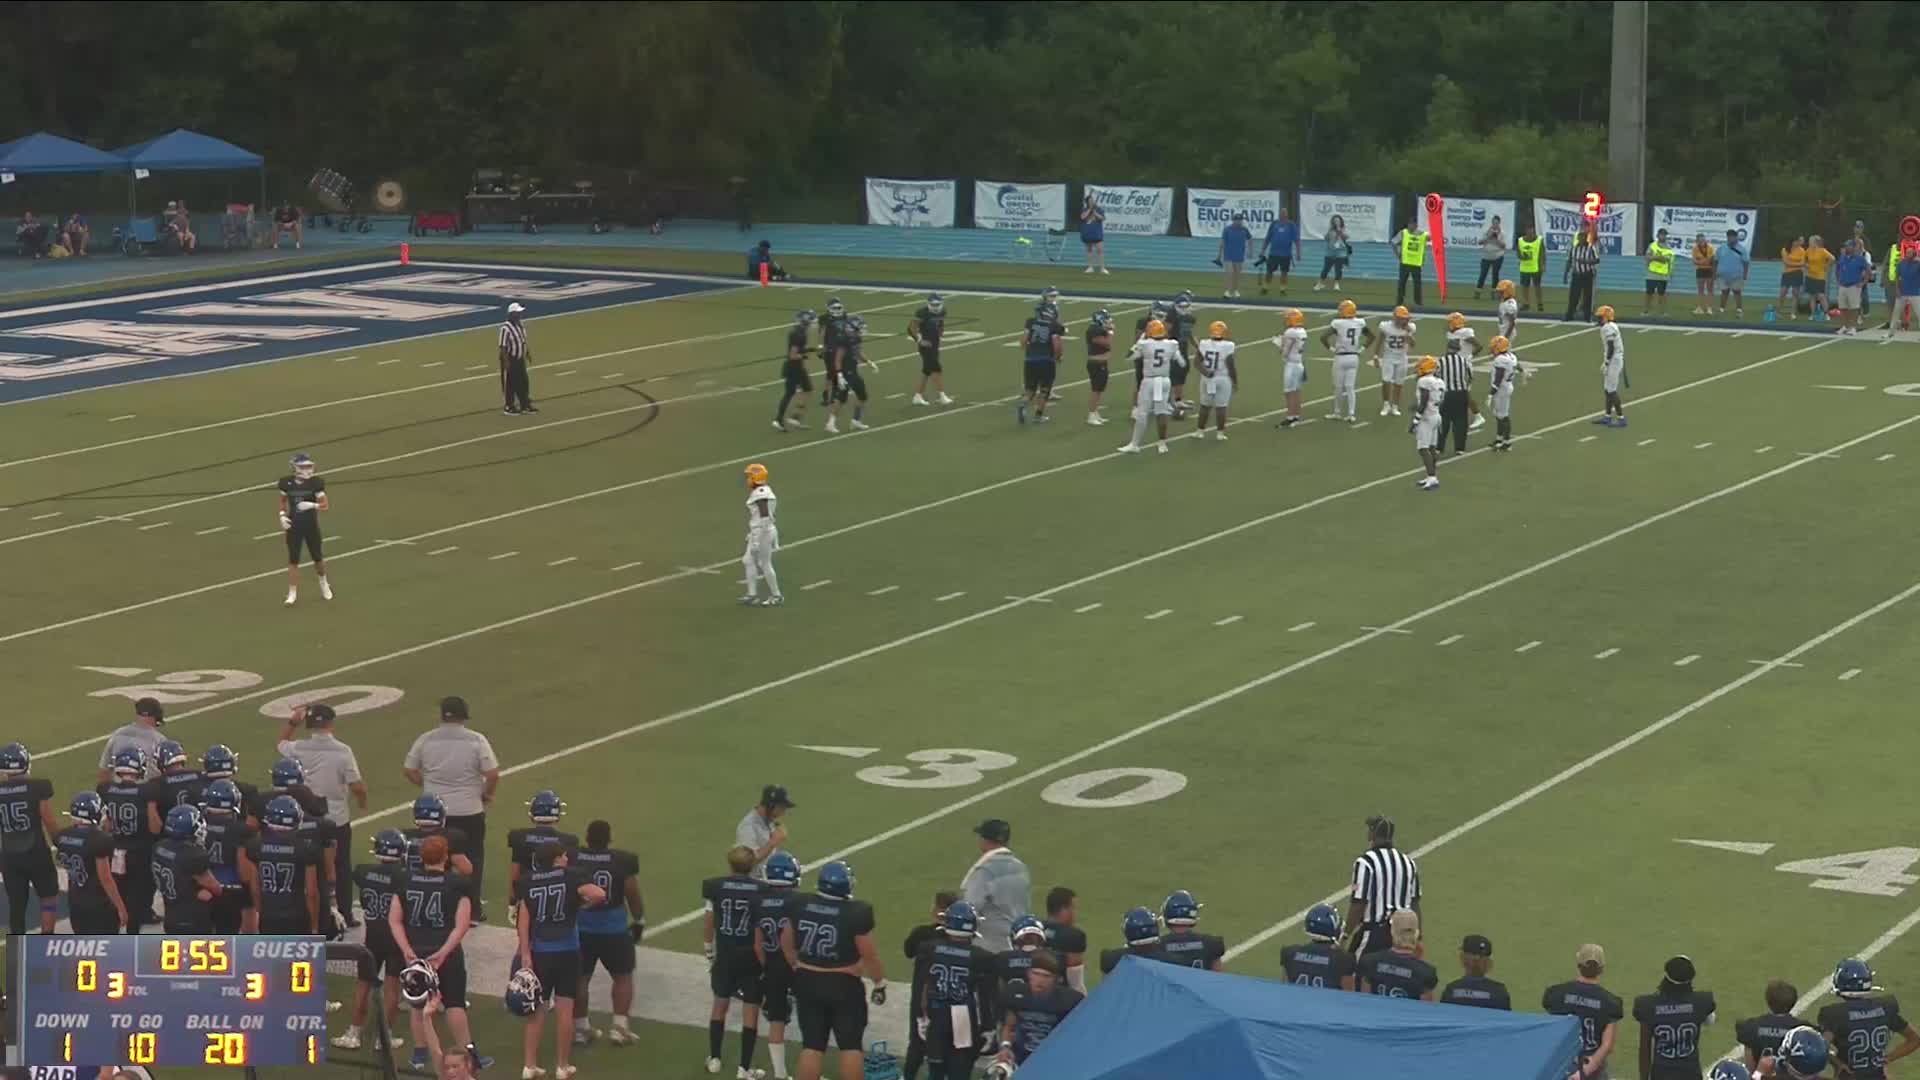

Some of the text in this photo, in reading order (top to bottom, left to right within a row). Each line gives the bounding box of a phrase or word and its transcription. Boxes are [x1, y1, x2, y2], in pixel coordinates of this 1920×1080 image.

[1126, 189, 1161, 206] Feet
[1584, 192, 1600, 216] 2
[1198, 208, 1275, 223] ENGLAND
[1346, 328, 1356, 346] 9
[1388, 335, 1405, 349] 22
[1153, 349, 1164, 368] 5
[1204, 351, 1220, 369] 51
[108, 802, 138, 835] 19
[406, 890, 445, 928] 74
[529, 882, 566, 921] 77
[719, 897, 751, 936] 17
[798, 919, 839, 960] 72
[1654, 1022, 1698, 1059] 20
[1848, 1025, 1888, 1069] 29
